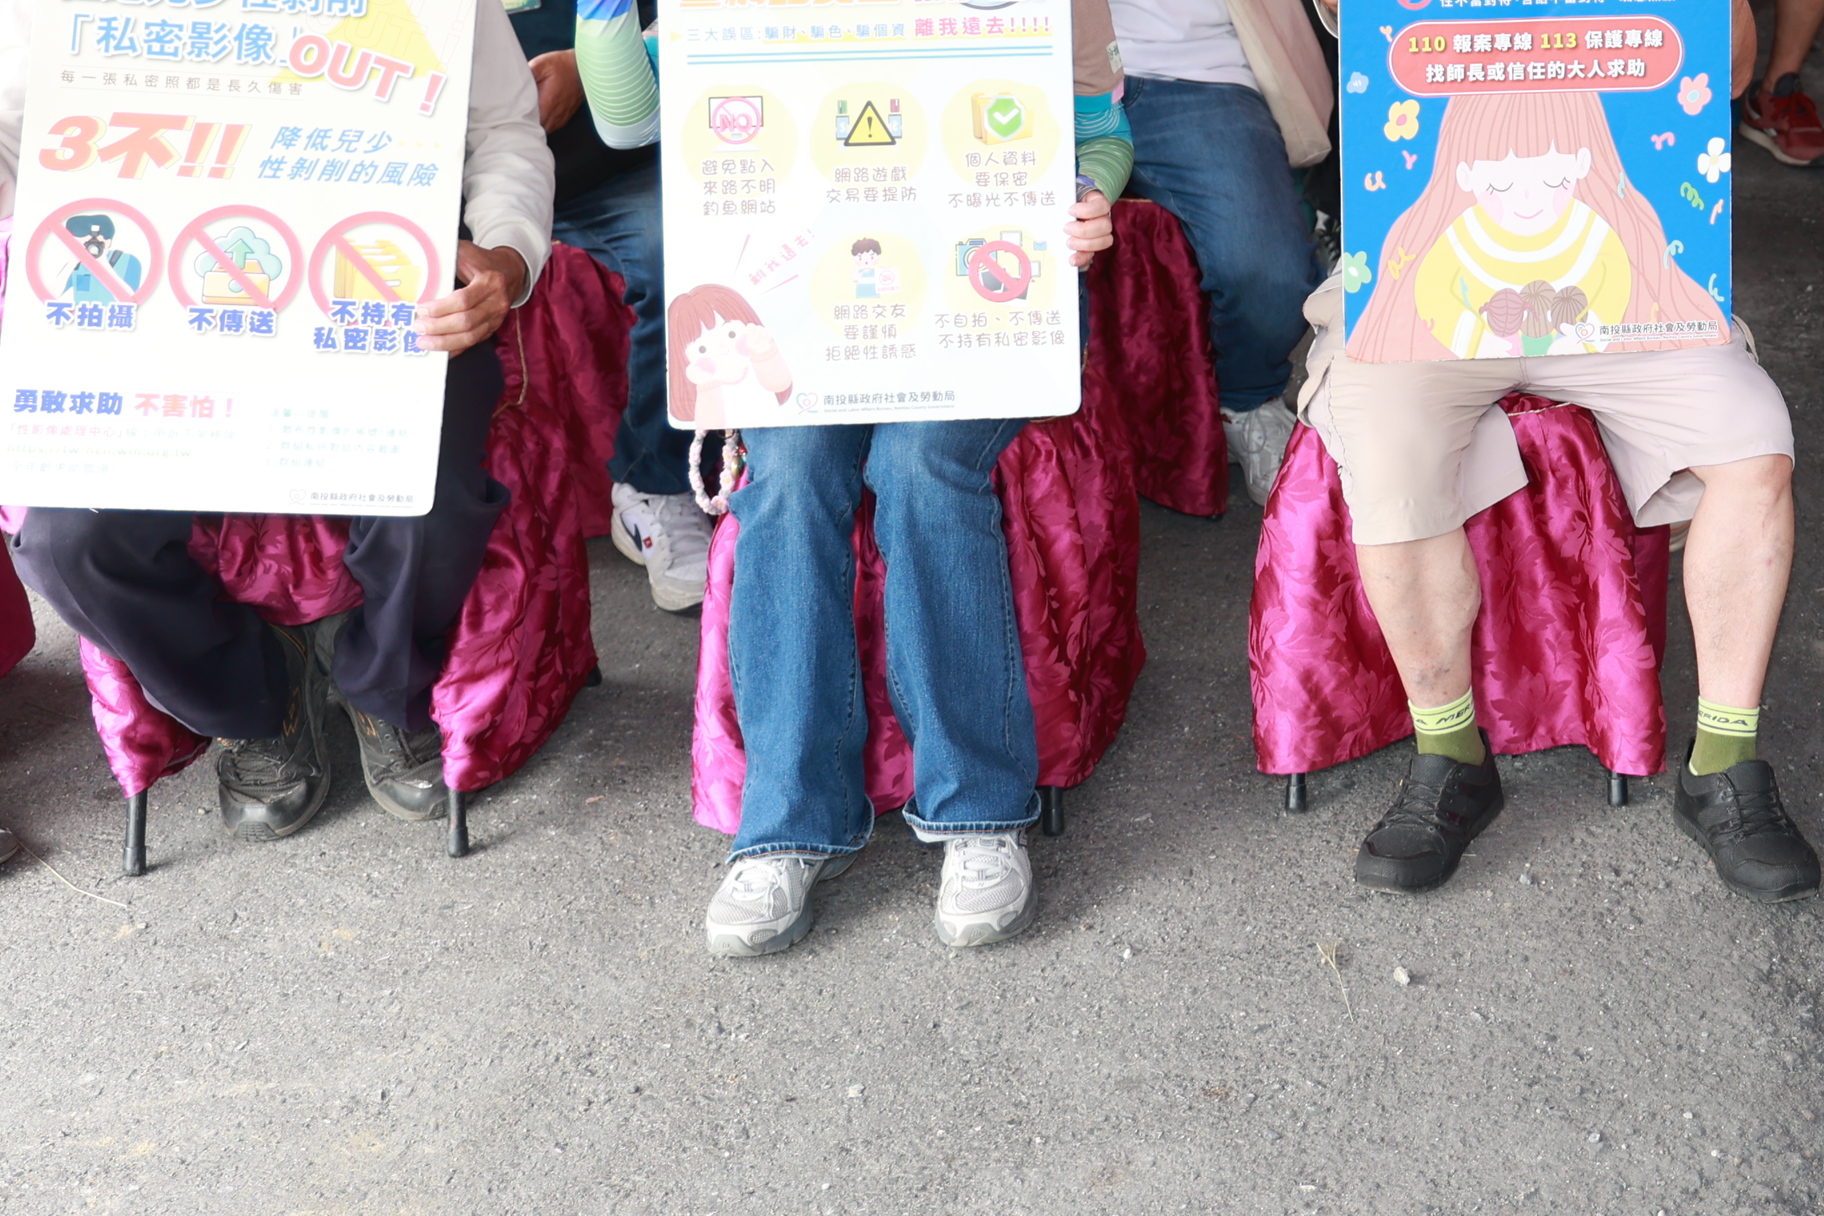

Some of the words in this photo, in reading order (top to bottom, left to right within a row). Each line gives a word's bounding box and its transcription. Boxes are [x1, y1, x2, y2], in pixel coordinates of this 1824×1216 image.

[1408, 35, 1446, 52] 110
[1452, 32, 1533, 53] 報案專線
[1540, 32, 1578, 49] 113
[1584, 28, 1664, 50] 保護專線
[1425, 58, 1646, 83] 找師長或信任的大人求助
[60, 69, 304, 96] 每一張私密照都是長久傷害
[269, 125, 393, 155] 降低兒少
[702, 158, 776, 176] 避免點入
[965, 150, 1037, 169] 個人資料
[258, 156, 440, 188] 性剝削的風險
[834, 166, 908, 184] 網路遊戲
[975, 171, 1028, 188] 要保密
[703, 178, 776, 196] 來路不明
[826, 186, 918, 205] 交易要提防
[703, 199, 777, 216] 釣魚網站
[947, 190, 1057, 209] 不曝光不傳送
[45, 300, 137, 330] 不拍攝
[187, 306, 277, 336] 不傳送
[833, 303, 907, 321] 網路交友
[934, 310, 1062, 329] 不自拍、不傳送
[844, 324, 898, 341] 要謹慎
[1599, 320, 1718, 336] 南投縣政府社會及勞動局
[938, 330, 1066, 350] 不持有私密影像
[825, 344, 918, 362] 拒絕性誘惑
[13, 389, 125, 416] 勇敢求助
[823, 390, 956, 406] 南投縣政府社會及勞動局
